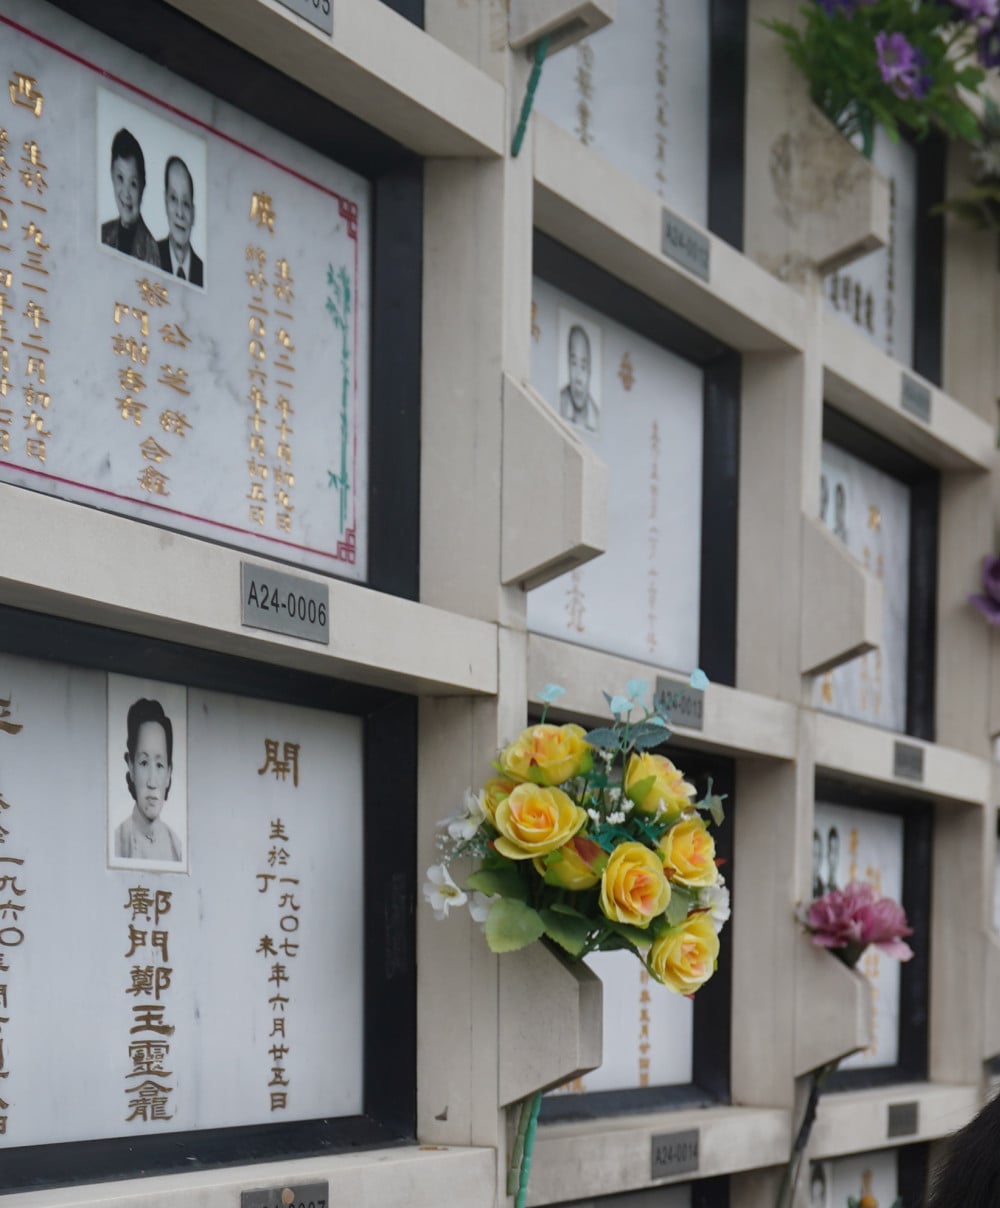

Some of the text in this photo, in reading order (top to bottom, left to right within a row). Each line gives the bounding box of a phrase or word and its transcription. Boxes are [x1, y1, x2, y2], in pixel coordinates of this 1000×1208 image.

[8, 70, 44, 119] 西
[247, 580, 327, 627] A24-0006
[257, 737, 301, 788] 開
